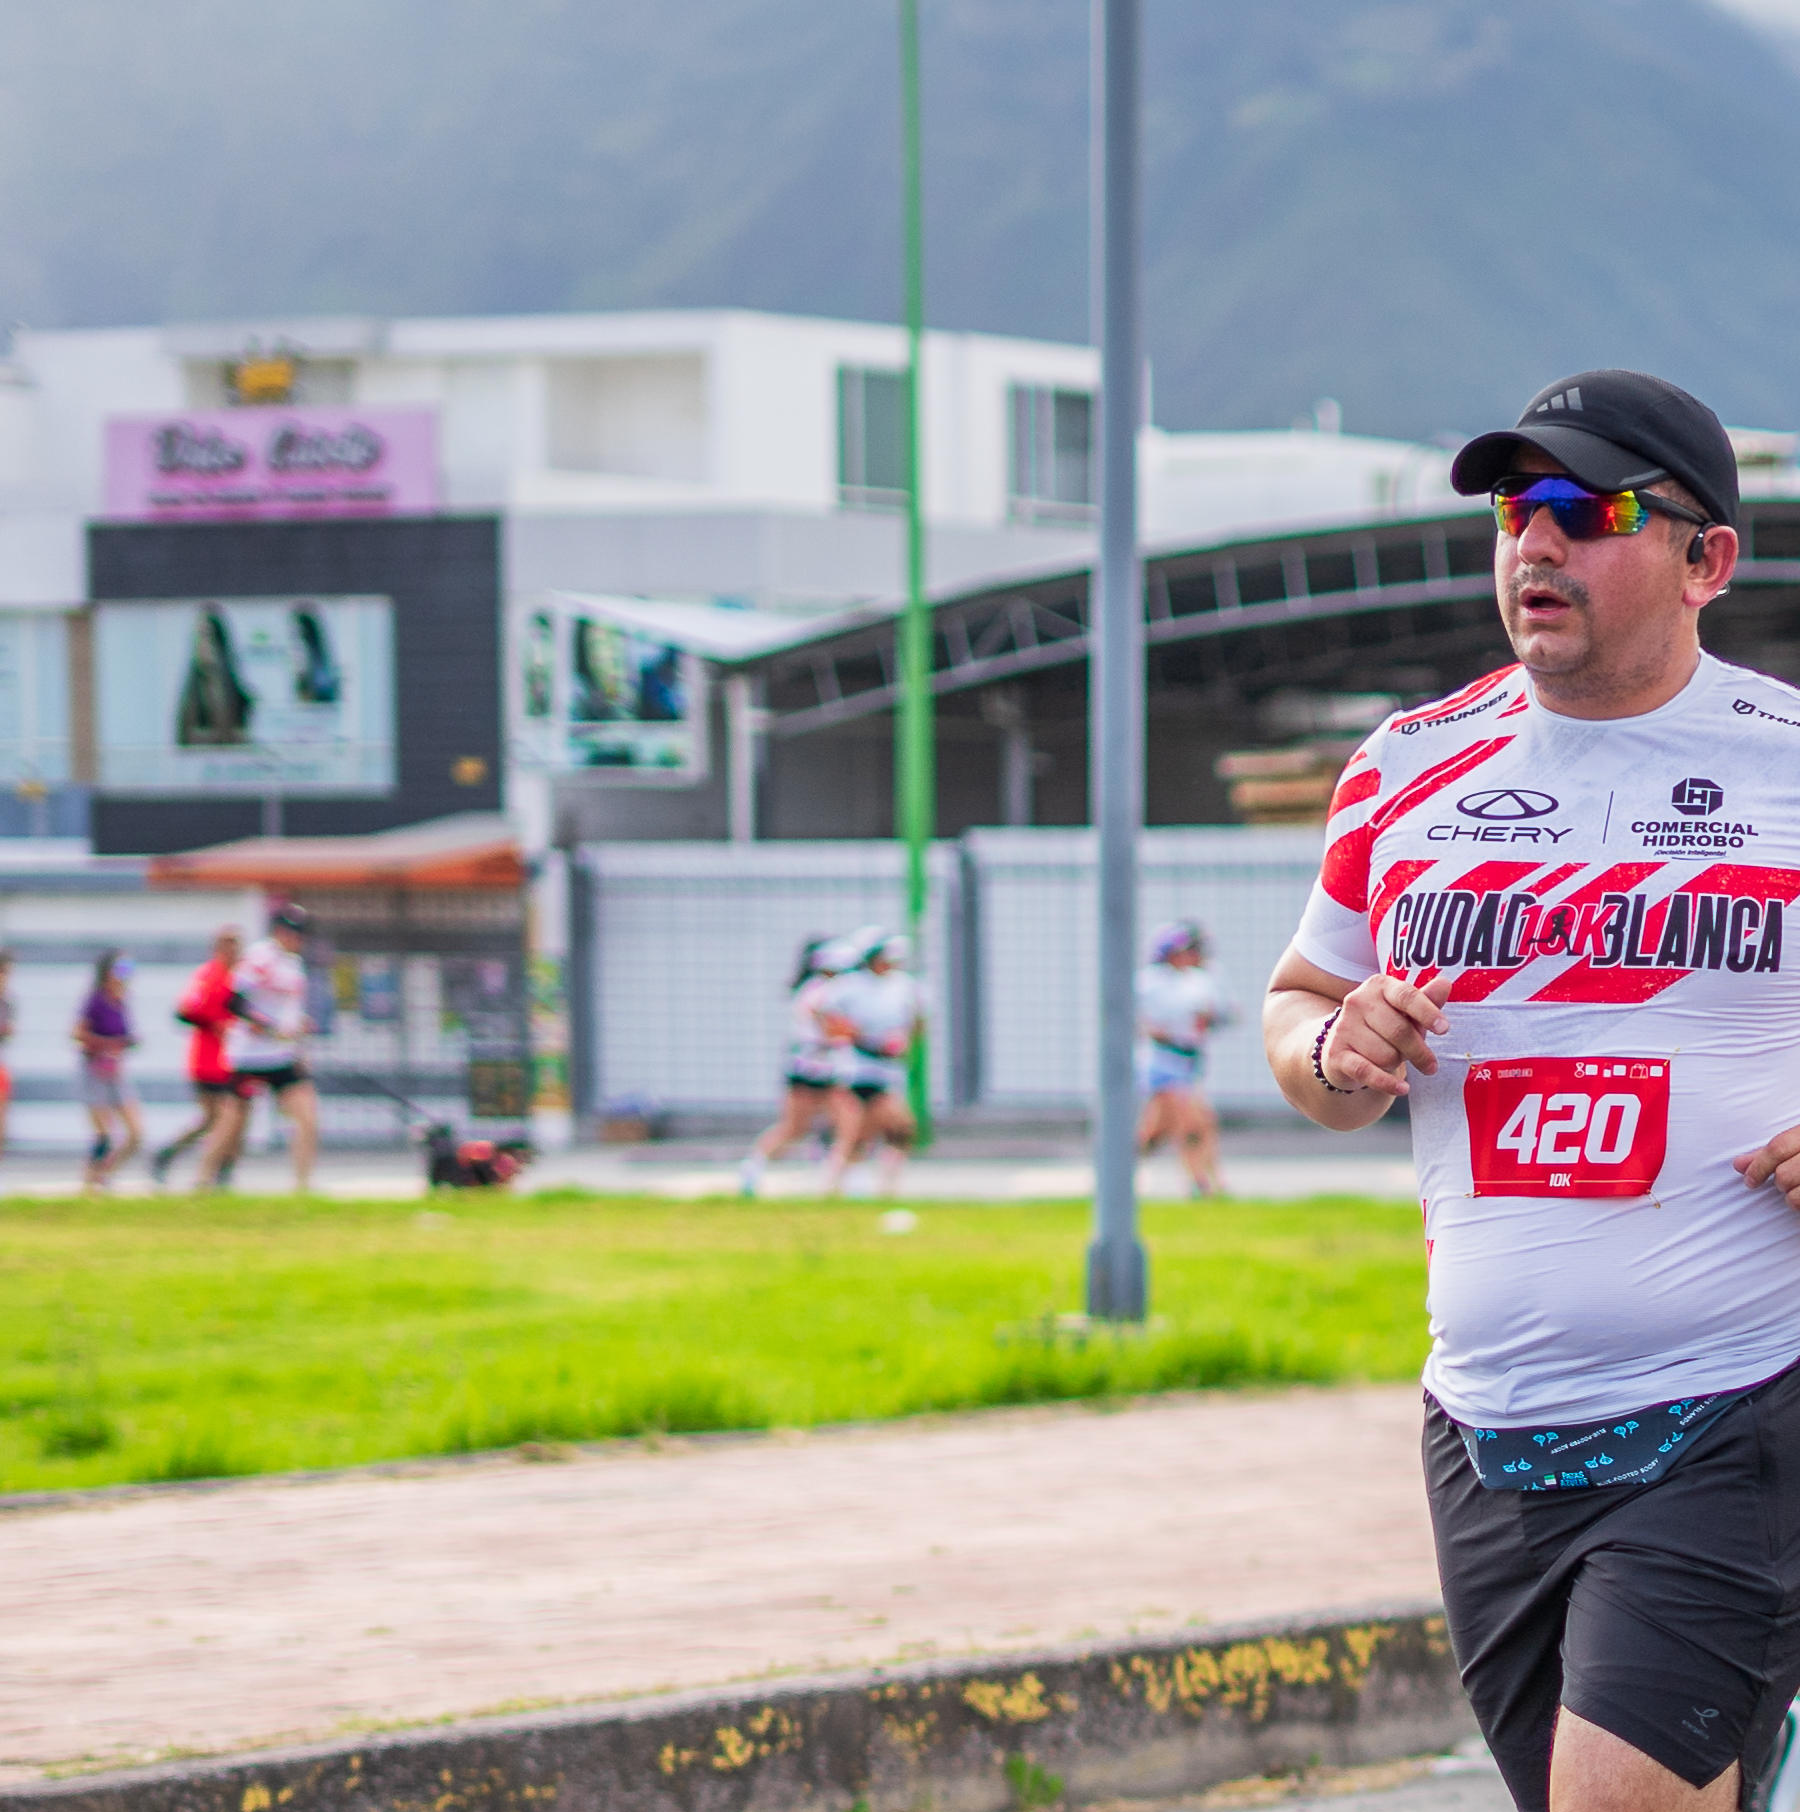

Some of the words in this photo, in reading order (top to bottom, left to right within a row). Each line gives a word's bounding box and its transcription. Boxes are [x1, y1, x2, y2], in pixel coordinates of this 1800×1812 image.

[1424, 691, 1508, 728] THUNDER
[1427, 825, 1574, 844] CHERY
[1631, 821, 1759, 836] COMERCIAL
[1642, 835, 1744, 848] HIDROBO
[1391, 891, 1530, 969] CIUDAD
[1518, 903, 1622, 958] 10K
[1590, 891, 1785, 974] BLANCA
[1496, 1093, 1642, 1165] 420
[1549, 1173, 1572, 1187] 10K
